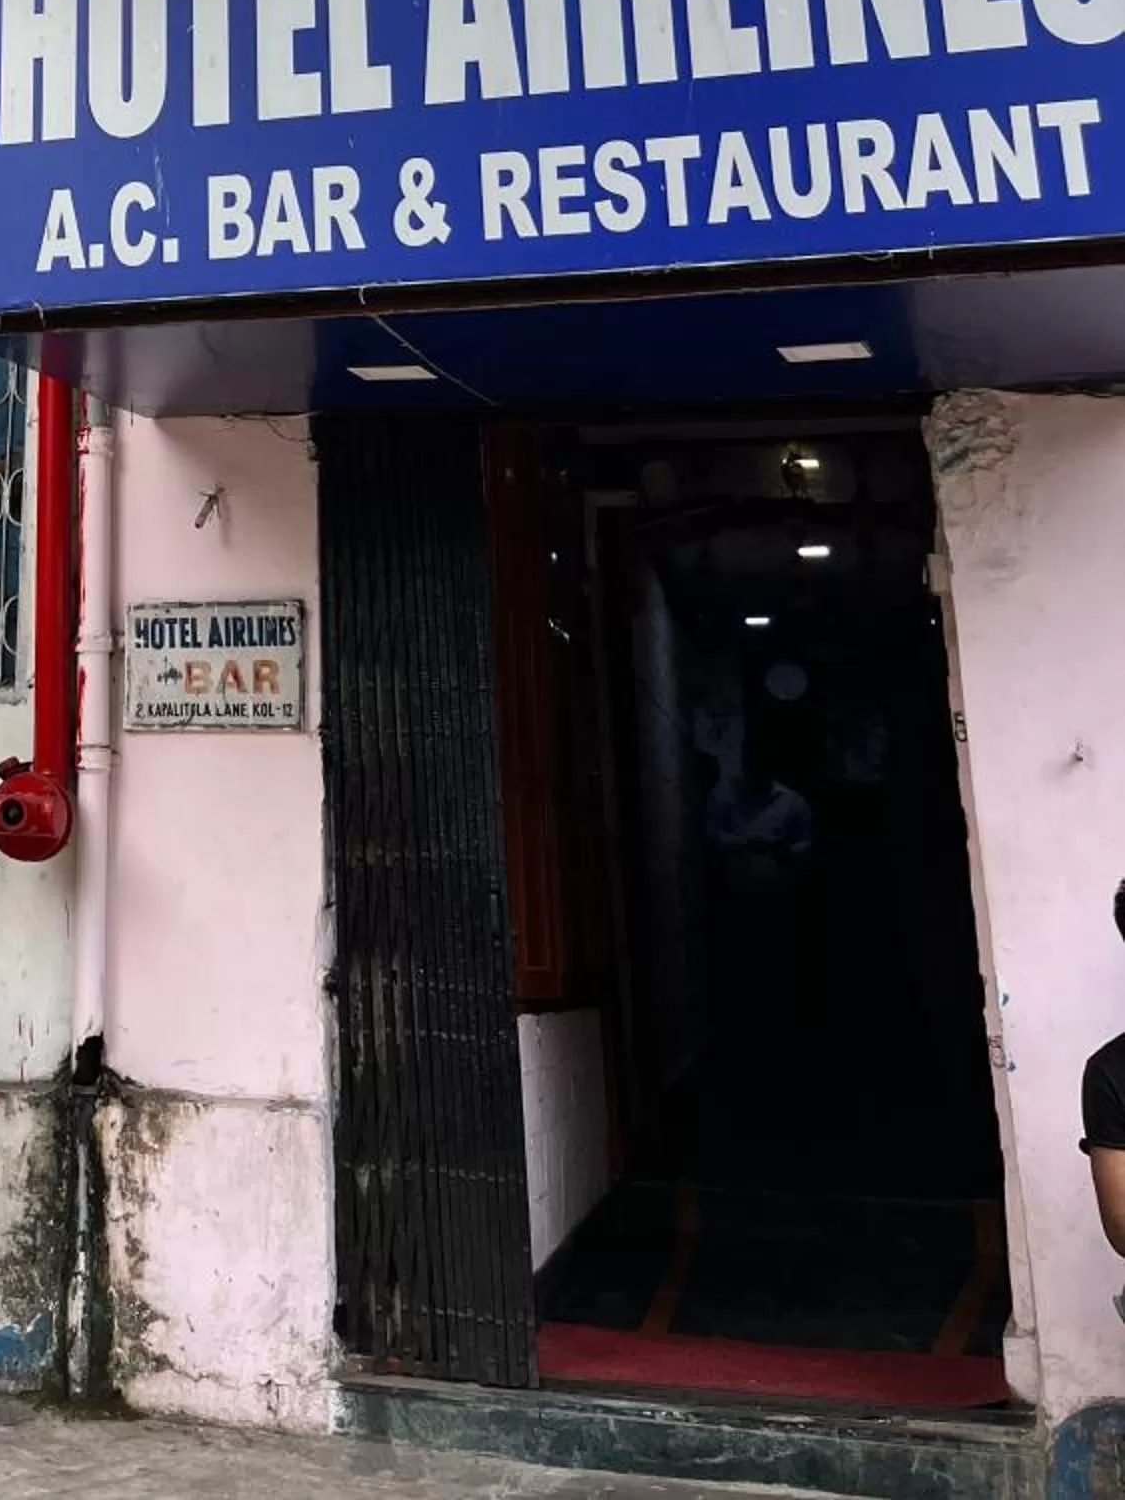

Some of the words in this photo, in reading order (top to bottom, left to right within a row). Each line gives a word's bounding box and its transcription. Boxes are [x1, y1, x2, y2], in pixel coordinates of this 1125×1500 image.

[35, 181, 179, 273] A.C.
[207, 165, 366, 260] BAR
[393, 157, 452, 247] &
[480, 98, 1101, 241] RESTAURANT
[135, 616, 202, 650] HOTEL
[208, 615, 296, 648] AIRLINES
[184, 659, 280, 695] BAR
